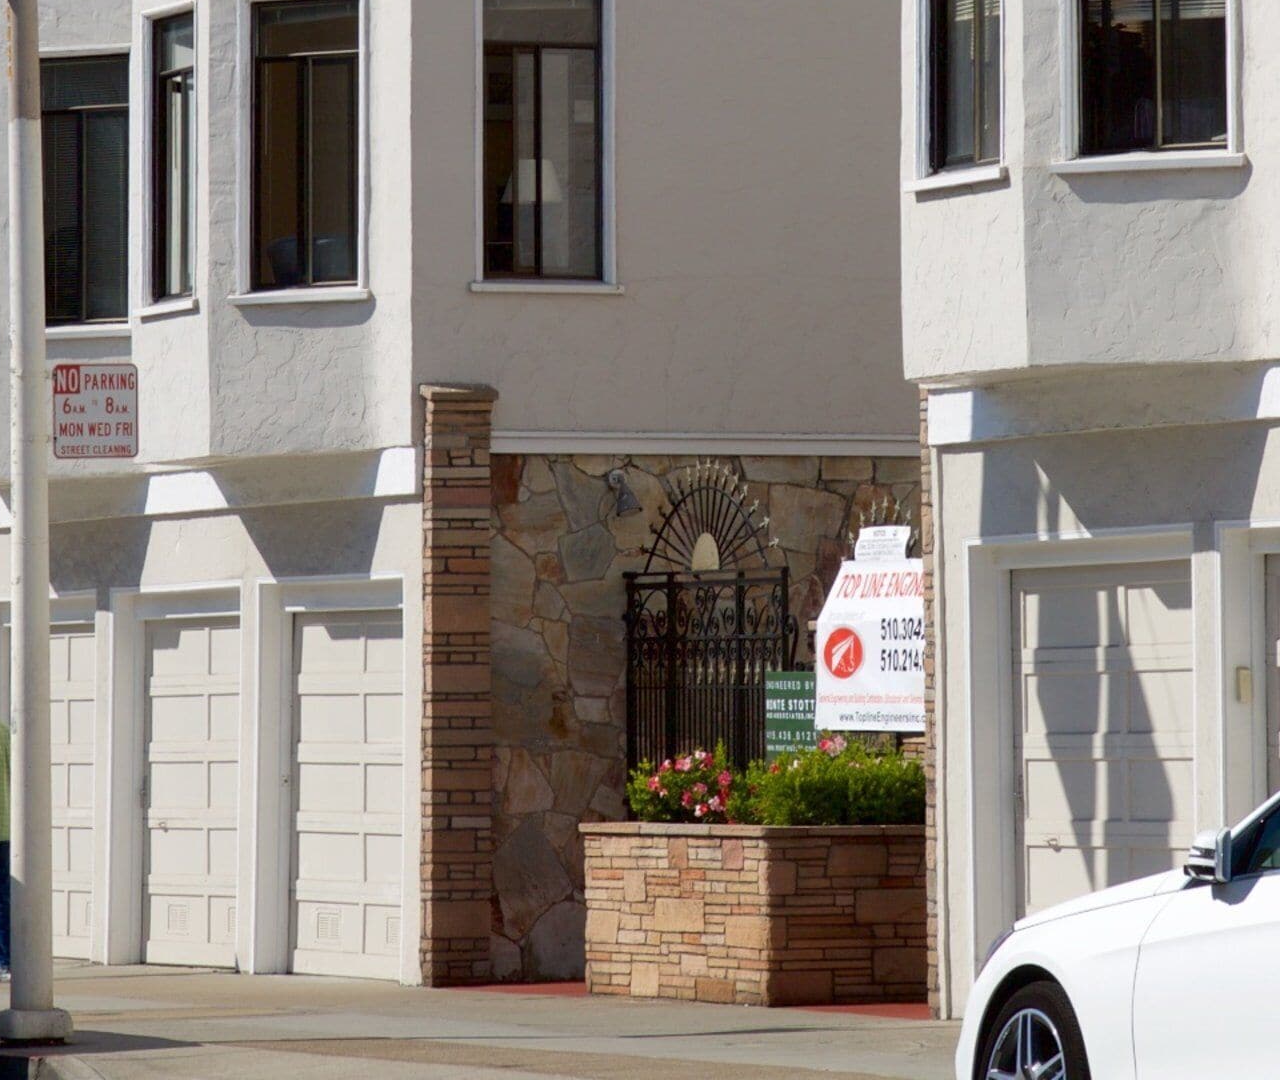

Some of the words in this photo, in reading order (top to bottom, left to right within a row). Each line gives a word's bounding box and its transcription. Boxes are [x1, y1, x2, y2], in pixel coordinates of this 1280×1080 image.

[56, 368, 79, 392] NO
[84, 373, 135, 391] PARKING
[59, 423, 84, 437] MON
[88, 422, 111, 436] WED
[115, 421, 133, 436] FRI
[61, 445, 89, 455] STREET
[92, 444, 132, 455] CLEANING
[836, 574, 862, 598] TOP
[861, 572, 888, 598] LINE
[788, 699, 815, 711] STOTT
